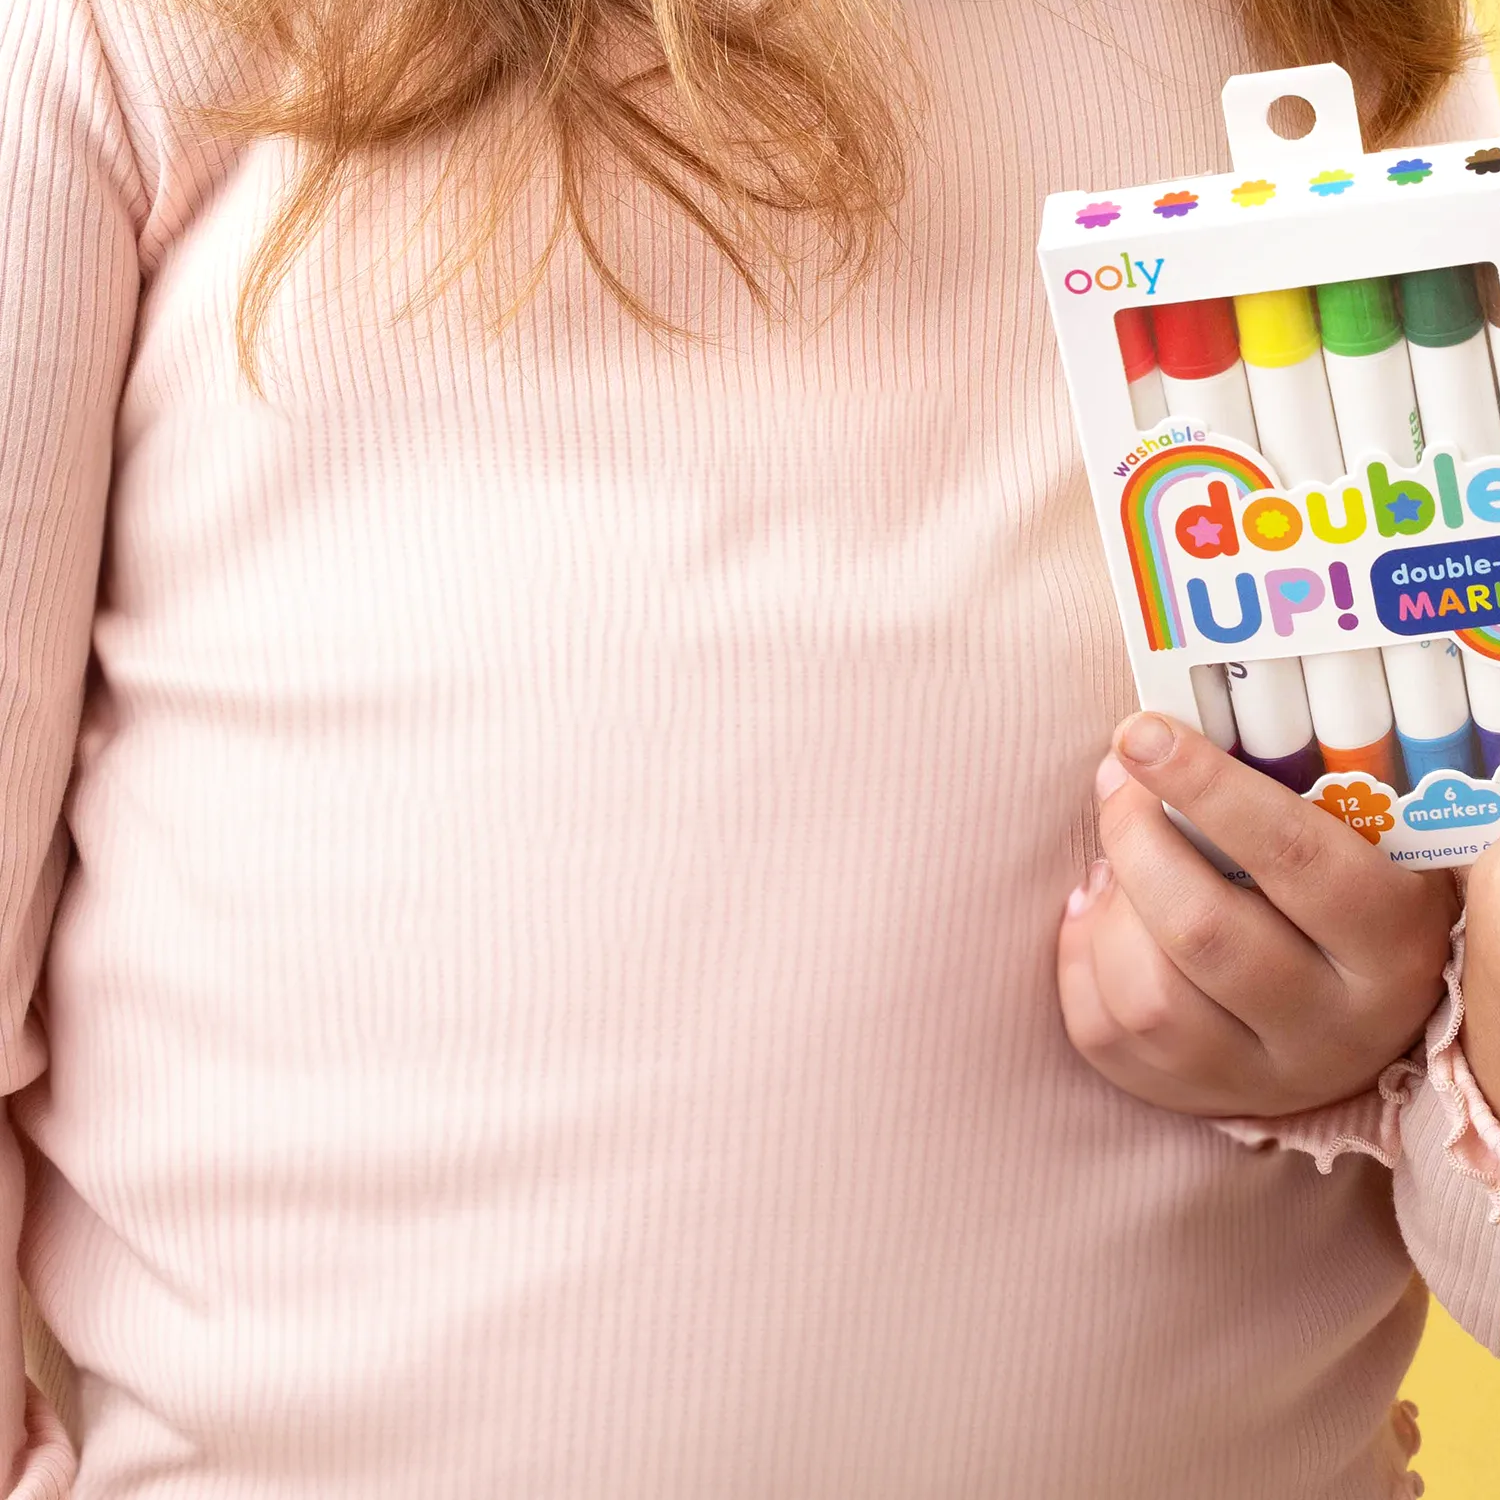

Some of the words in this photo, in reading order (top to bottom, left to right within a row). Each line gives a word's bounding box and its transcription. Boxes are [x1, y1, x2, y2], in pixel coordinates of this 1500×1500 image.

[1064, 252, 1165, 295] ooly
[1113, 425, 1206, 477] washable
[1186, 561, 1359, 644] UP!
[1444, 786, 1457, 801] 6
[1336, 797, 1360, 812] 12
[1408, 802, 1498, 822] markers
[1390, 844, 1478, 861] Marqueurs
